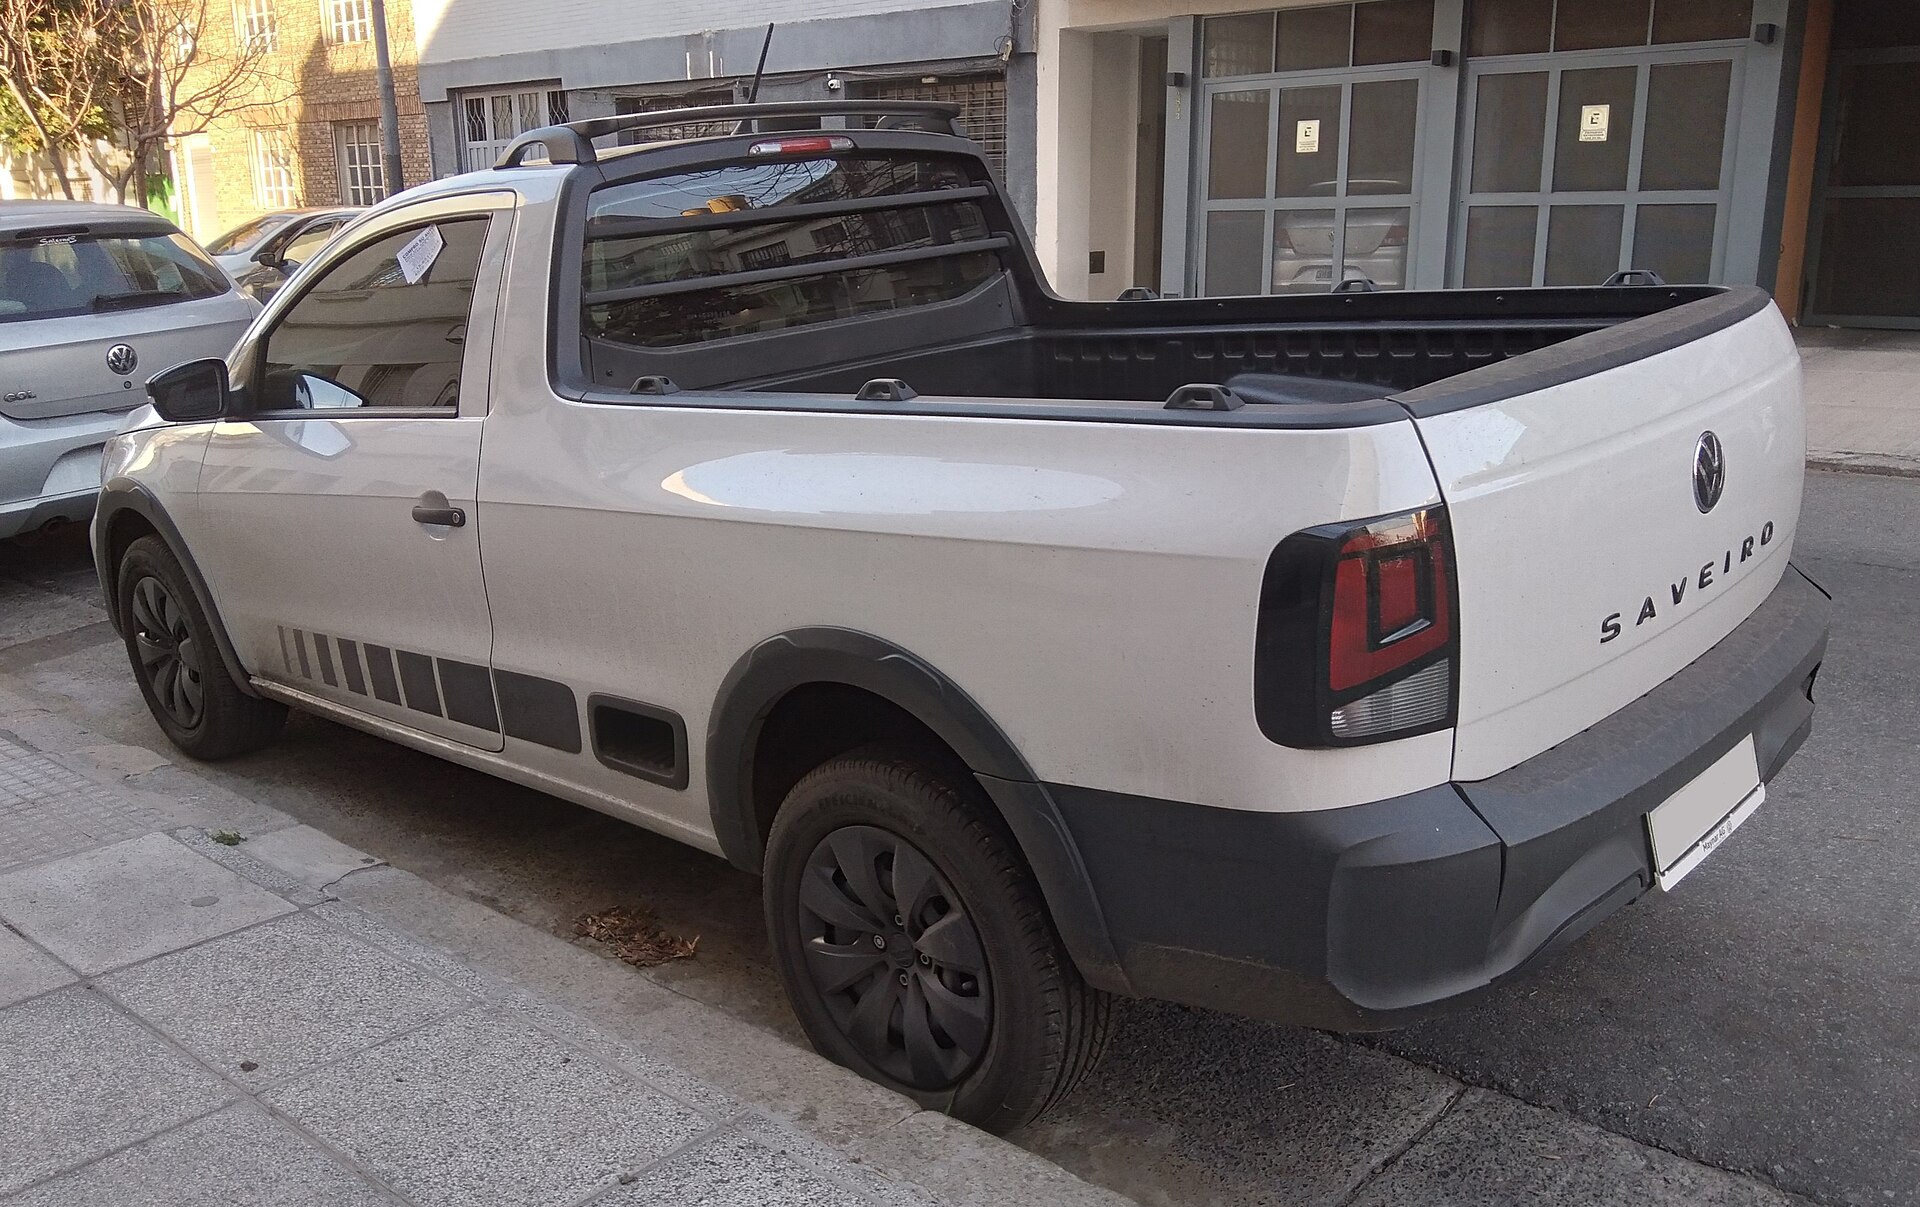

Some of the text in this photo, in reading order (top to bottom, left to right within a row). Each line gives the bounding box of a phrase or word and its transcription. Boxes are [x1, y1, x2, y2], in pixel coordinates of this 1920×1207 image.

[3, 390, 37, 403] GOL
[1600, 520, 1774, 644] SAVEIRO
[1719, 825, 1726, 838] AG
